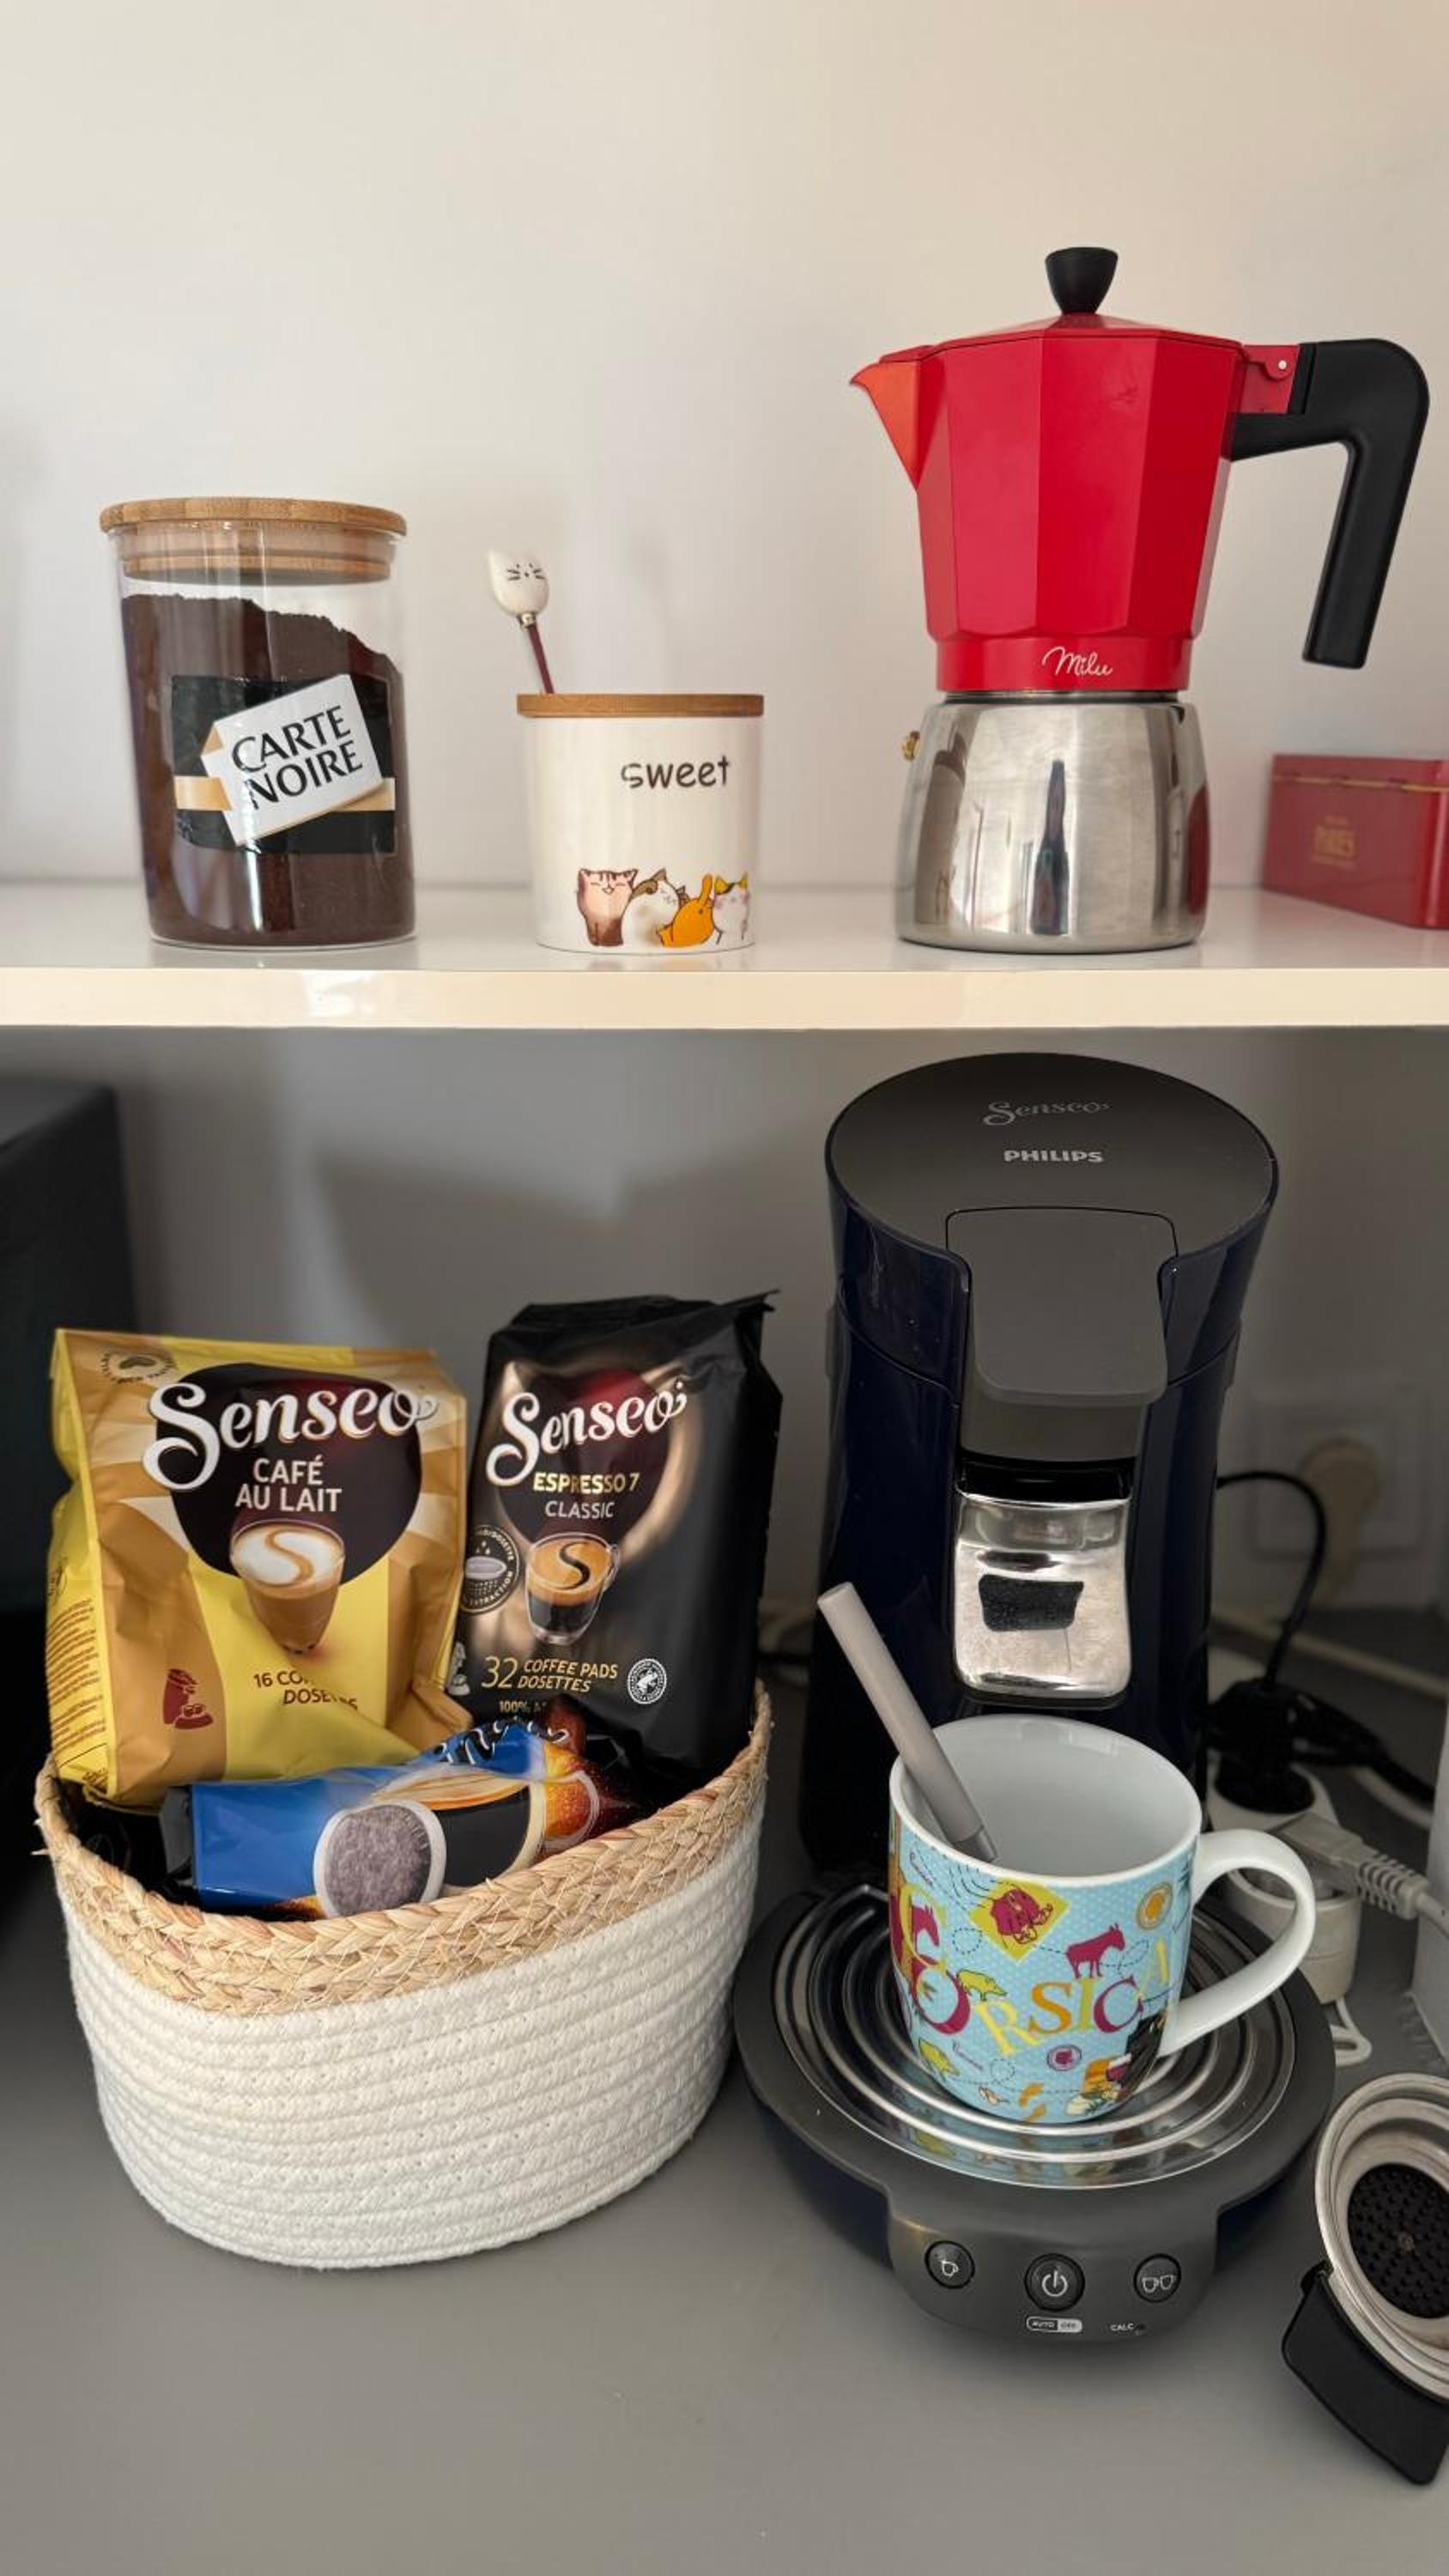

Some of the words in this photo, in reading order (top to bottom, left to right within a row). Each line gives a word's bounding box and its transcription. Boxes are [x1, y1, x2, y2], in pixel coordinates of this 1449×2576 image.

[1042, 646, 1113, 677] Milu
[232, 705, 351, 773] CARTE
[244, 740, 364, 811] NOIRE
[621, 755, 731, 789] sweet
[983, 1101, 1113, 1126] Senseo
[1003, 1150, 1104, 1163] PHILIPS
[142, 1382, 440, 1491] Senseo
[486, 1381, 688, 1486] Senseo
[252, 1454, 324, 1485] CAFÉ
[532, 1471, 627, 1495] ESPRESSO
[627, 1472, 640, 1492] 7
[235, 1483, 271, 1511] AU
[280, 1487, 343, 1513] LAIT
[544, 1499, 615, 1520] CLASSIC
[253, 1672, 274, 1688] 16
[481, 1656, 518, 1688] 32
[518, 1675, 592, 1693] DOSETTES
[523, 1658, 579, 1675] COFFEE
[579, 1663, 619, 1680] PADS
